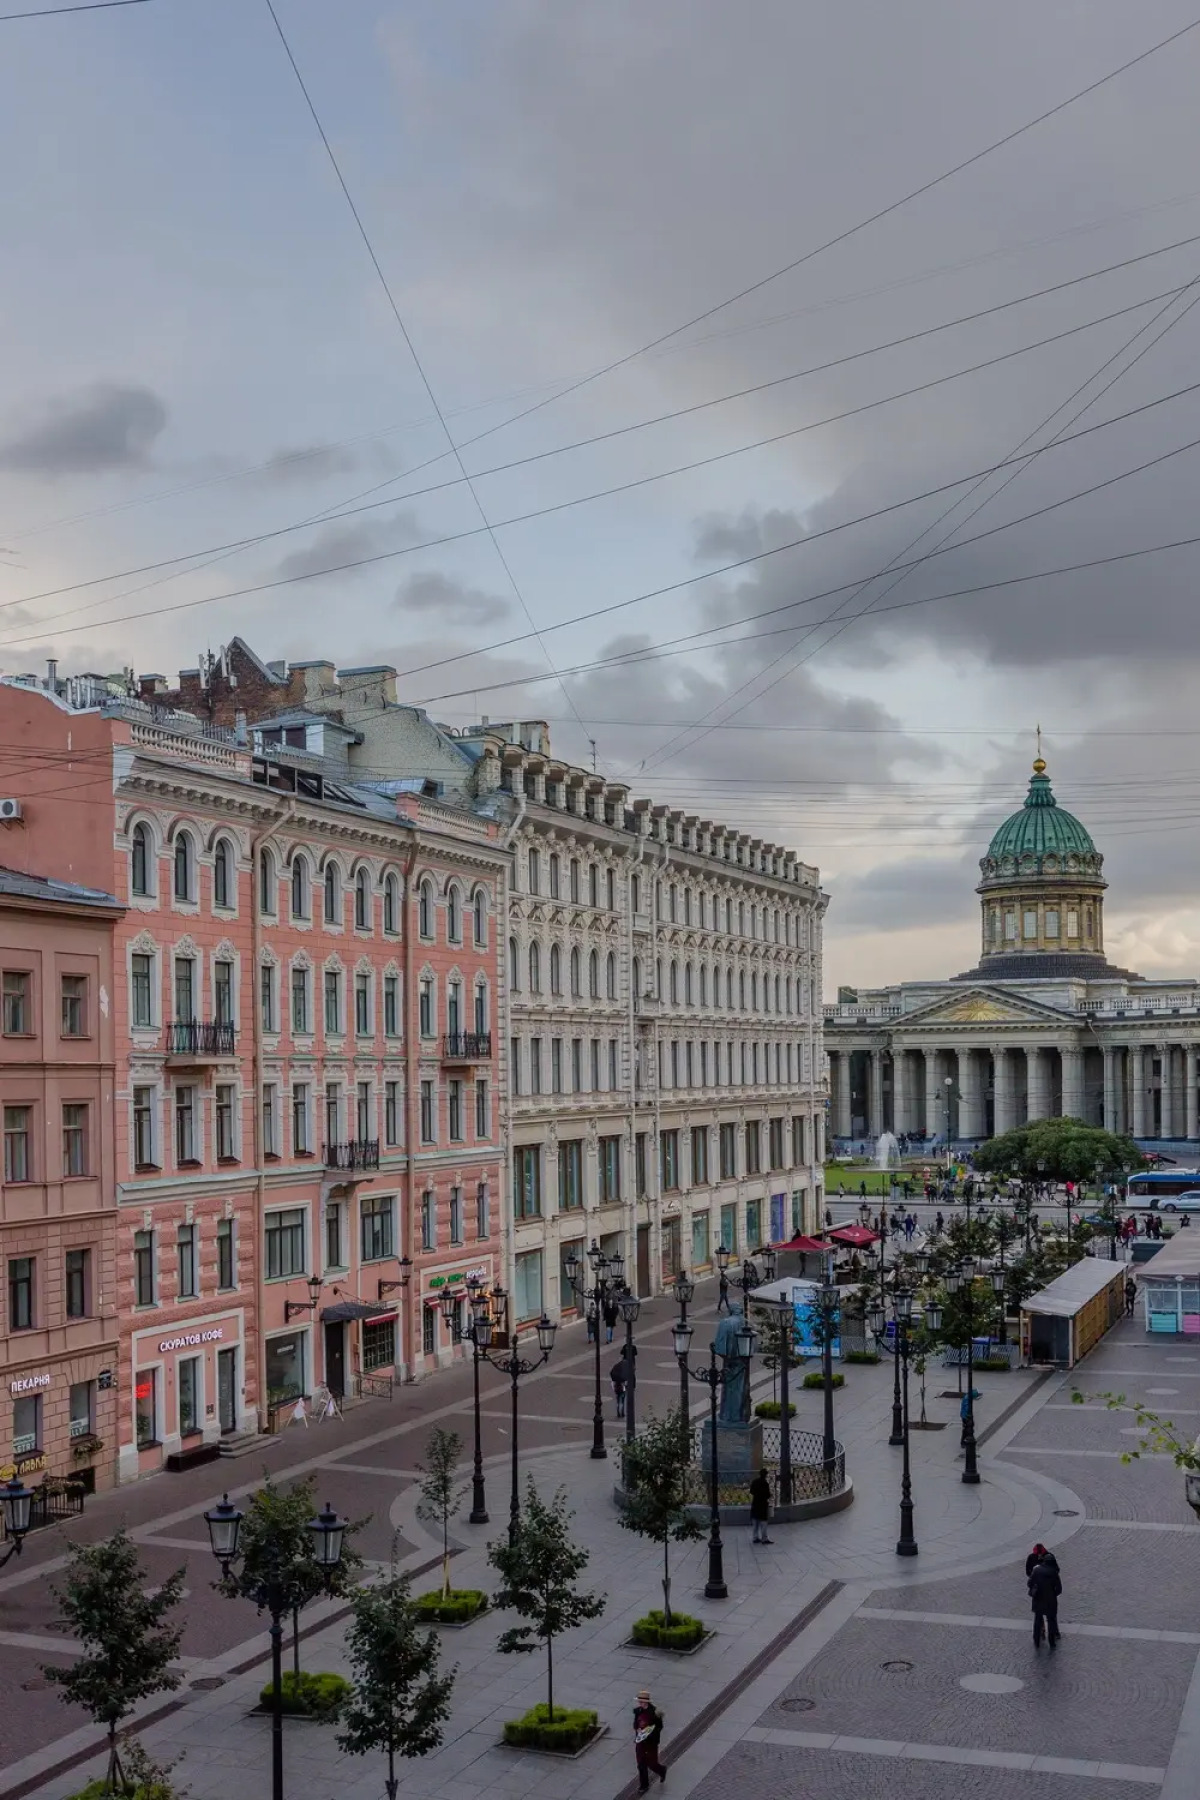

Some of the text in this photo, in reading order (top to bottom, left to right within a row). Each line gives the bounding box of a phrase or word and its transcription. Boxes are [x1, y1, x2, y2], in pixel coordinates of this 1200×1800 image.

[160, 1328, 223, 1351] СКУРАТОВ КОФЕ
[11, 1374, 50, 1393] ПЕКАРНЯ
